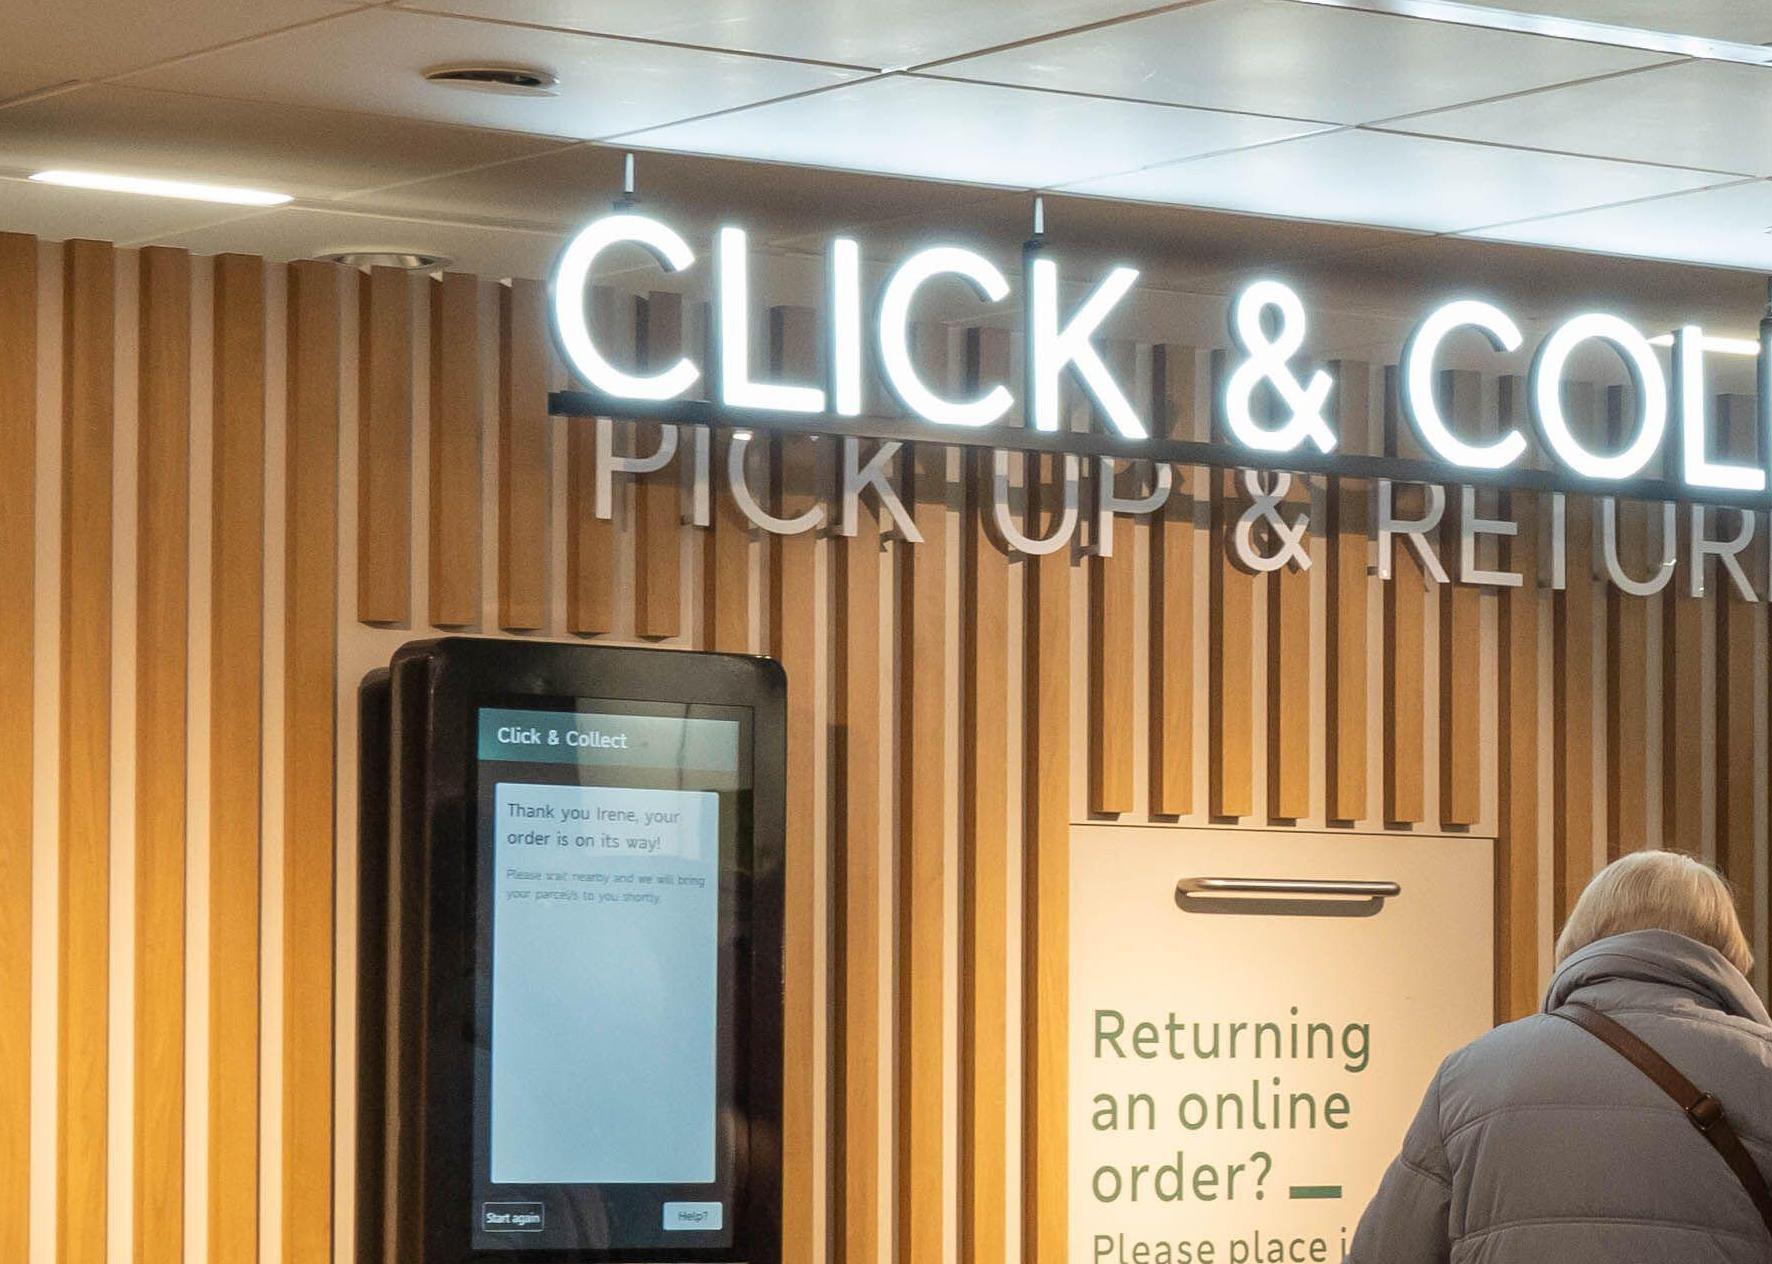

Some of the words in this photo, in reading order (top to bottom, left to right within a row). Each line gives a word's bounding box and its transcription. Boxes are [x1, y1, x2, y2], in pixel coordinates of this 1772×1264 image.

[553, 214, 1148, 439] CLICK
[1226, 280, 1338, 453] &
[595, 419, 925, 543] PICK
[992, 449, 1173, 558] UP
[1235, 469, 1313, 572] &
[497, 727, 541, 745] Click
[547, 730, 560, 746] &
[566, 731, 628, 749] Collect
[507, 803, 555, 820] Thank
[561, 808, 590, 827] you
[597, 807, 639, 825] Irene,
[645, 811, 681, 829] your
[507, 831, 551, 846] order
[557, 832, 569, 847] is
[575, 836, 595, 847] on
[601, 833, 620, 848] its
[626, 836, 662, 853] way!
[506, 869, 543, 881] Please
[572, 872, 609, 885] nearby
[614, 873, 634, 884] and
[678, 875, 706, 889] bring
[506, 890, 532, 902] your
[583, 891, 594, 902] to
[598, 893, 618, 904] you
[1093, 1006, 1371, 1074] Returning
[1091, 1093, 1156, 1132] an
[1178, 1076, 1351, 1131] online
[1091, 1151, 1273, 1204] order?
[486, 1212, 511, 1224] Start
[512, 1213, 541, 1226] again
[677, 1210, 709, 1224] Help?
